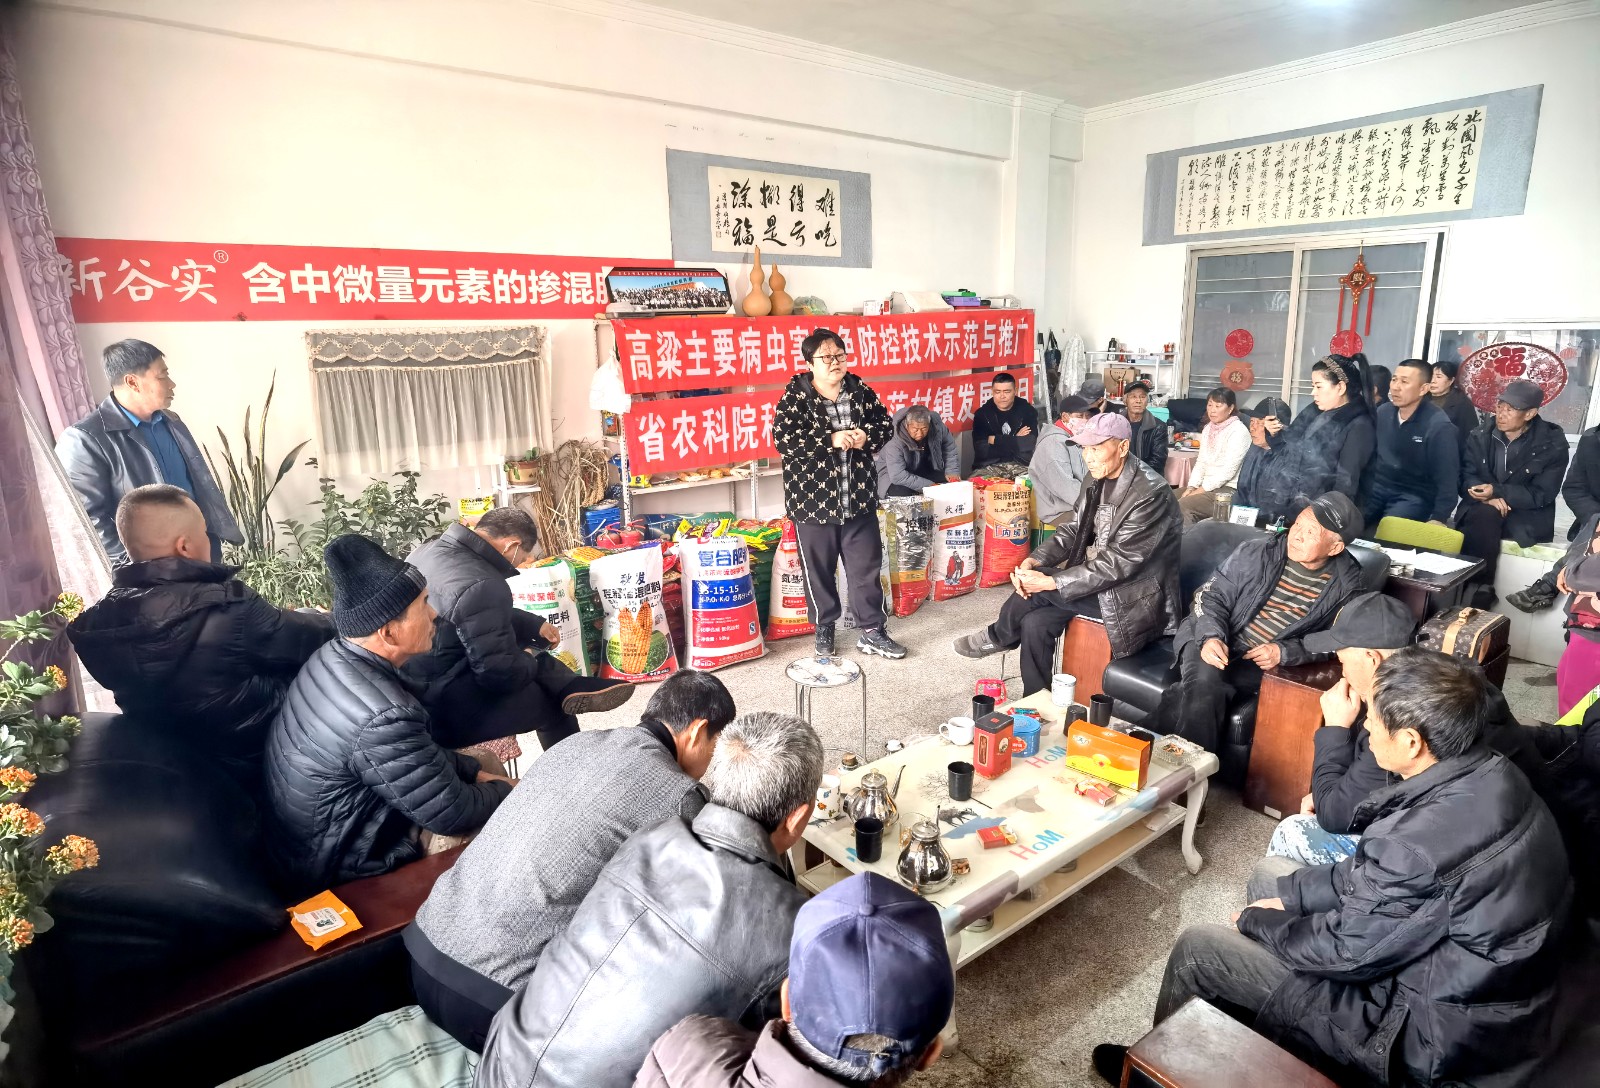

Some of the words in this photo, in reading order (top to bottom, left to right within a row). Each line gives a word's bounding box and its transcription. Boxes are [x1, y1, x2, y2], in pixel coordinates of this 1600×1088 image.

[625, 316, 1029, 381] 高粱主要病虫害色防控技术示范与推广
[1493, 346, 1527, 377] 福
